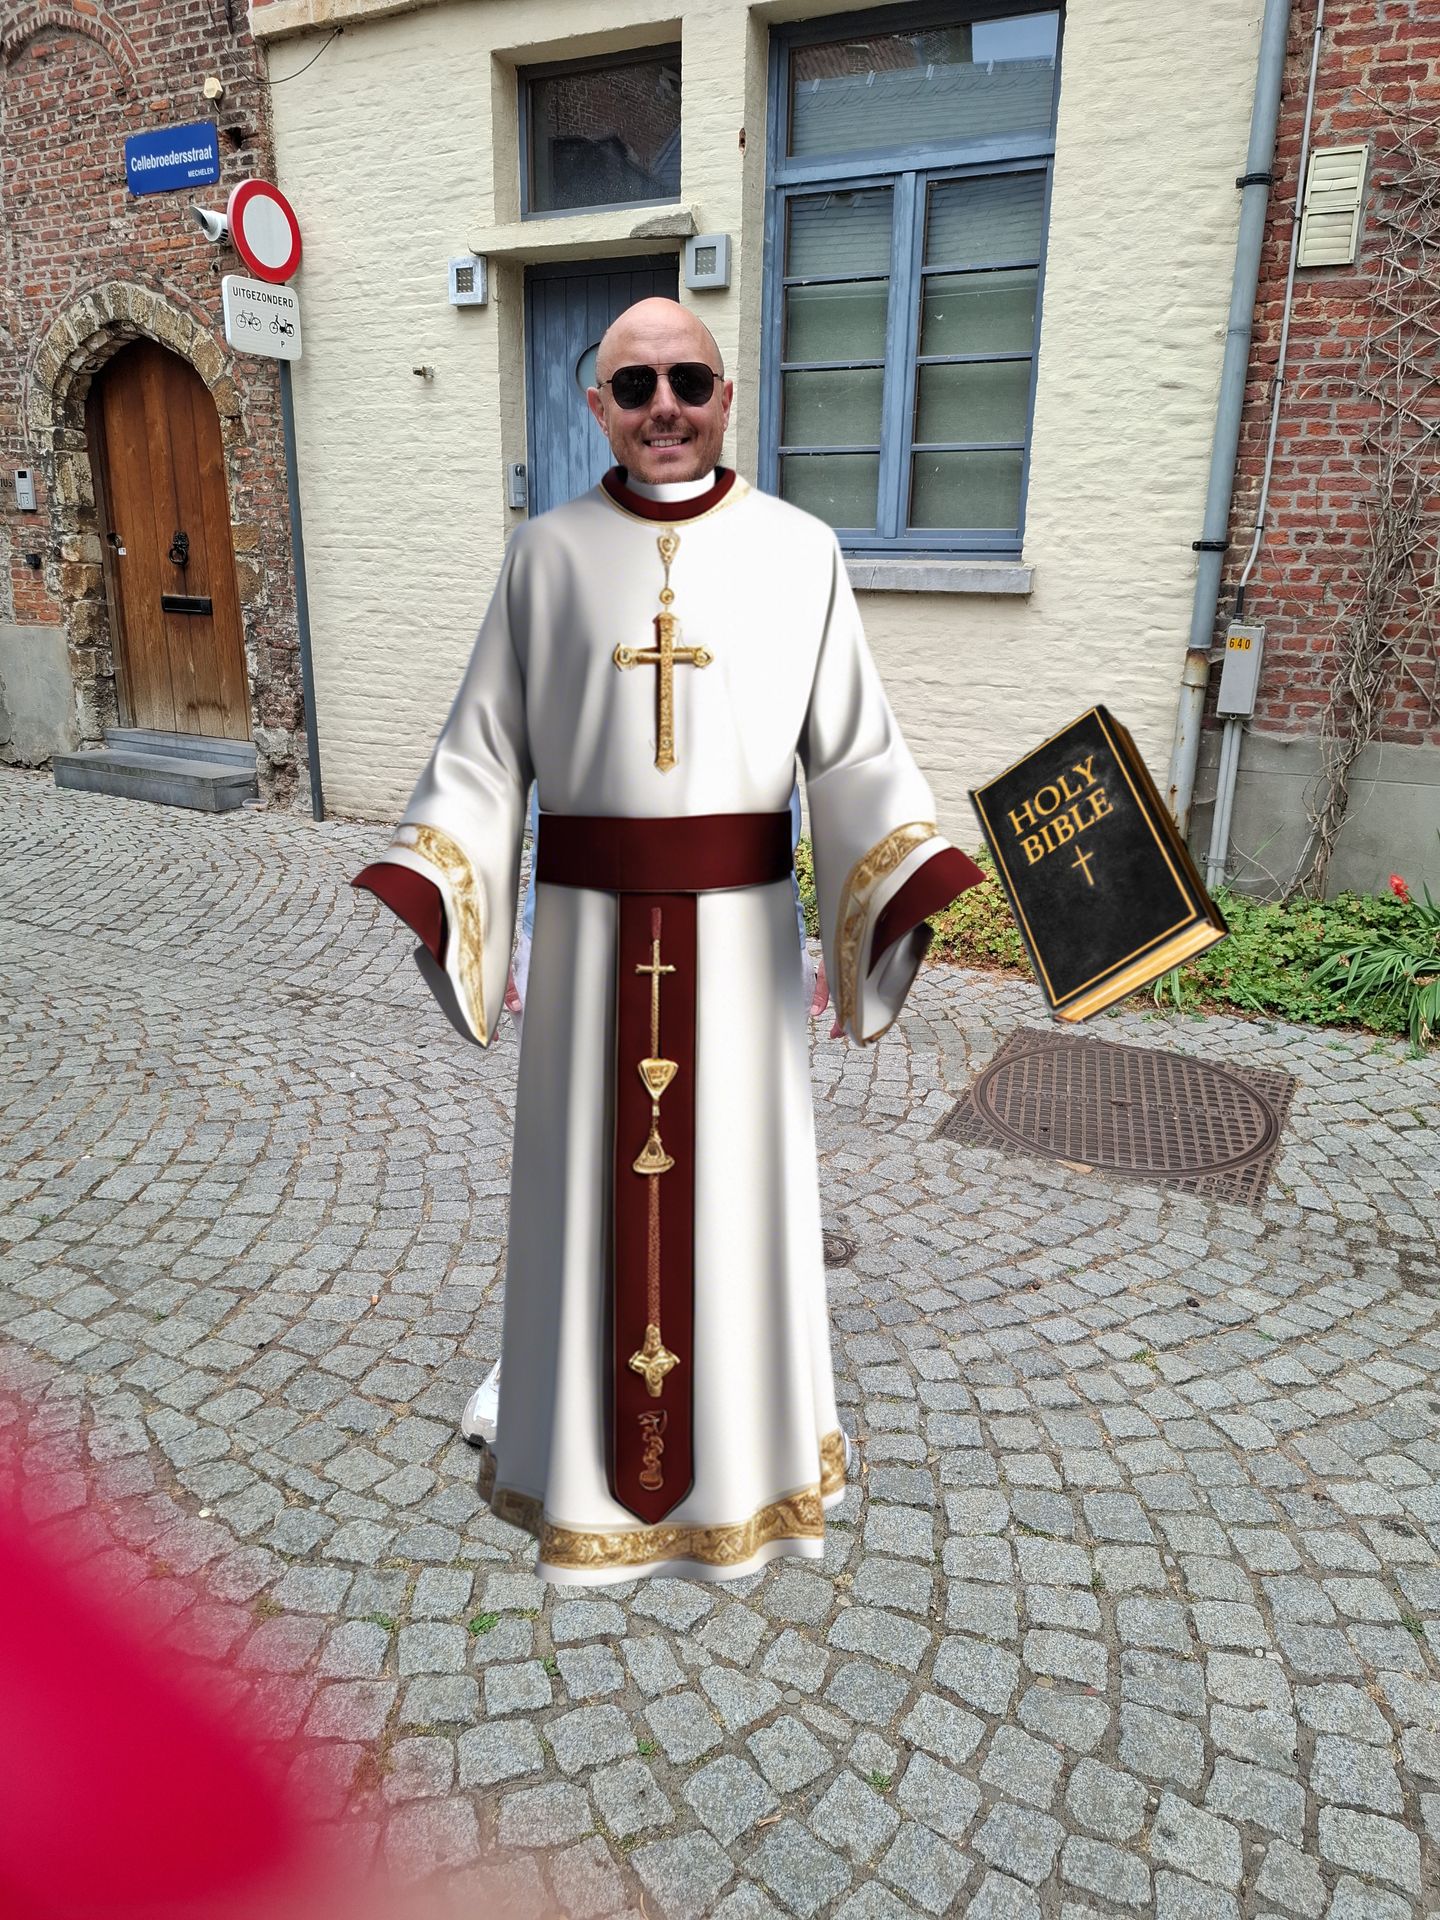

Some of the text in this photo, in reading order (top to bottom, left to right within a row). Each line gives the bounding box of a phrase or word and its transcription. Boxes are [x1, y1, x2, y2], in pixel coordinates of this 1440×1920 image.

[131, 144, 213, 172] Cellebroedersstraat
[187, 167, 214, 178] MECHELEN
[232, 286, 294, 308] UITGEZONDERD
[1229, 637, 1251, 650] 640
